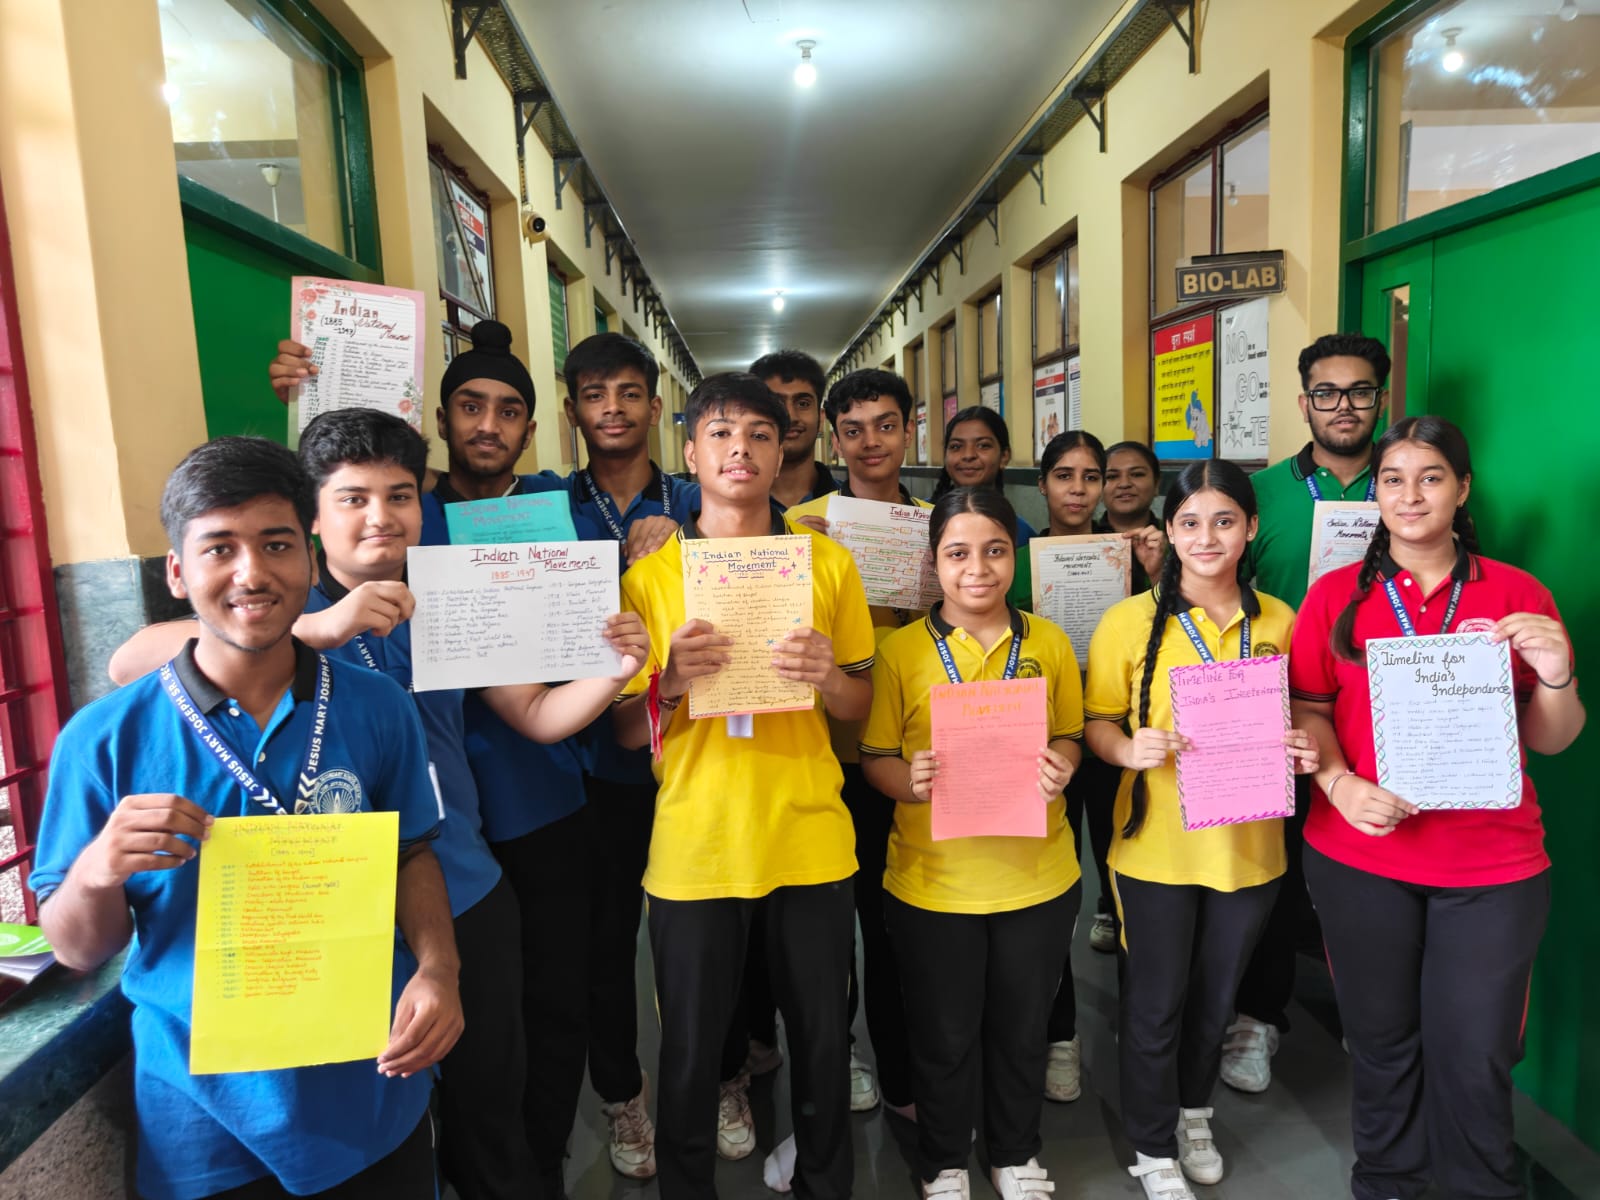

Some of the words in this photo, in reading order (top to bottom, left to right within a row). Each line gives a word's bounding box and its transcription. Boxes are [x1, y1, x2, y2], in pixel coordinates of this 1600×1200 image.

[1183, 266, 1277, 295] BIO-LAB
[333, 298, 379, 318] Indian
[889, 506, 911, 516] Indian
[470, 548, 520, 562] Indian
[528, 546, 569, 560] National
[544, 556, 597, 569] Movement
[702, 550, 742, 560] Indian
[750, 549, 789, 558] National
[728, 560, 778, 571] Movement
[1453, 580, 1462, 604] JOSEP
[1397, 608, 1411, 629] MARY
[358, 642, 377, 668] MARY
[937, 641, 951, 664] JOSEP
[1007, 642, 1020, 671] JOSEPH
[1193, 638, 1209, 661] MARY
[1242, 642, 1250, 658] ARY
[1380, 651, 1435, 666] Timeline
[1442, 651, 1466, 669] for
[319, 663, 332, 702] JOSEPH
[1004, 669, 1013, 680] RY
[1415, 668, 1456, 683] India's
[176, 696, 209, 734] JOSEPH
[313, 703, 327, 737] MARY
[203, 732, 231, 762] MARY
[307, 737, 322, 773] JESUS
[227, 760, 259, 792] JESUS
